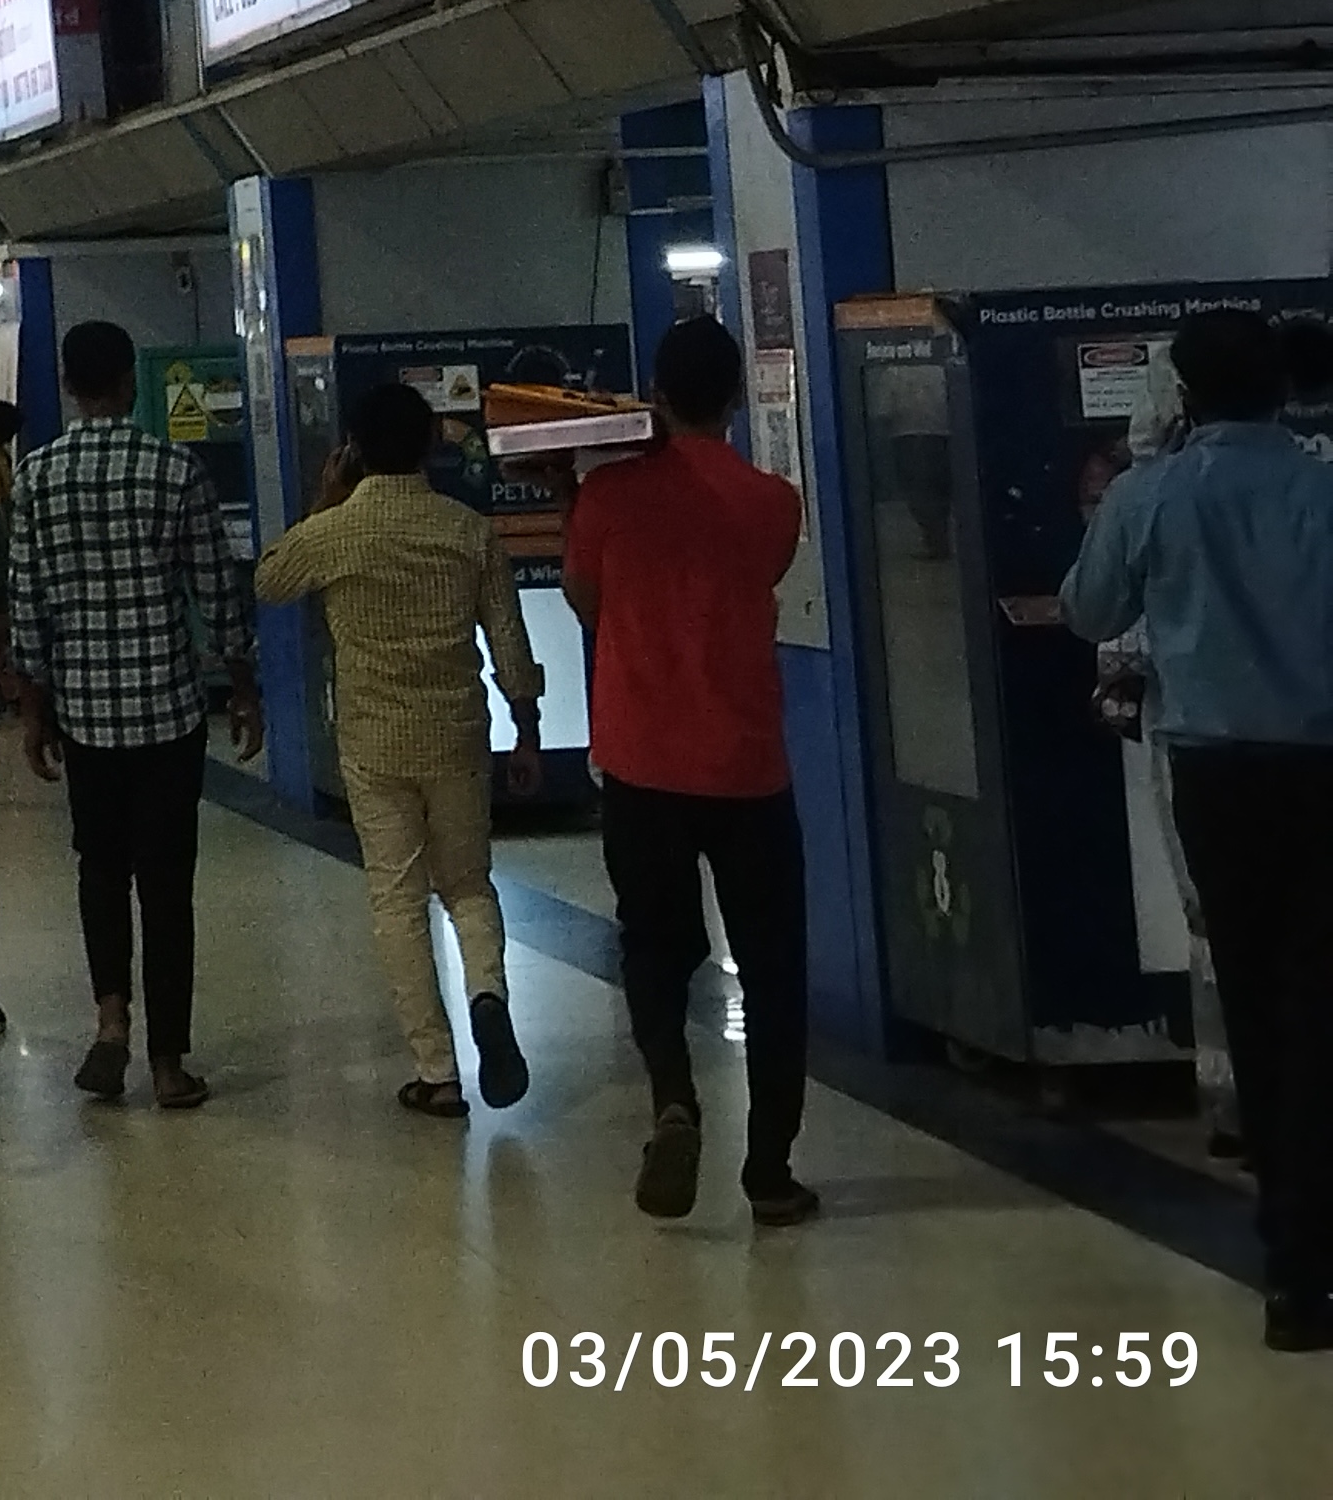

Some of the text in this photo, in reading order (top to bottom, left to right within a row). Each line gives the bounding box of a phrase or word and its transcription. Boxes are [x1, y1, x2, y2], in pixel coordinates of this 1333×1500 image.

[980, 306, 1039, 325] Plastic
[1043, 304, 1096, 322] Bottle
[1101, 300, 1182, 321] Crushing
